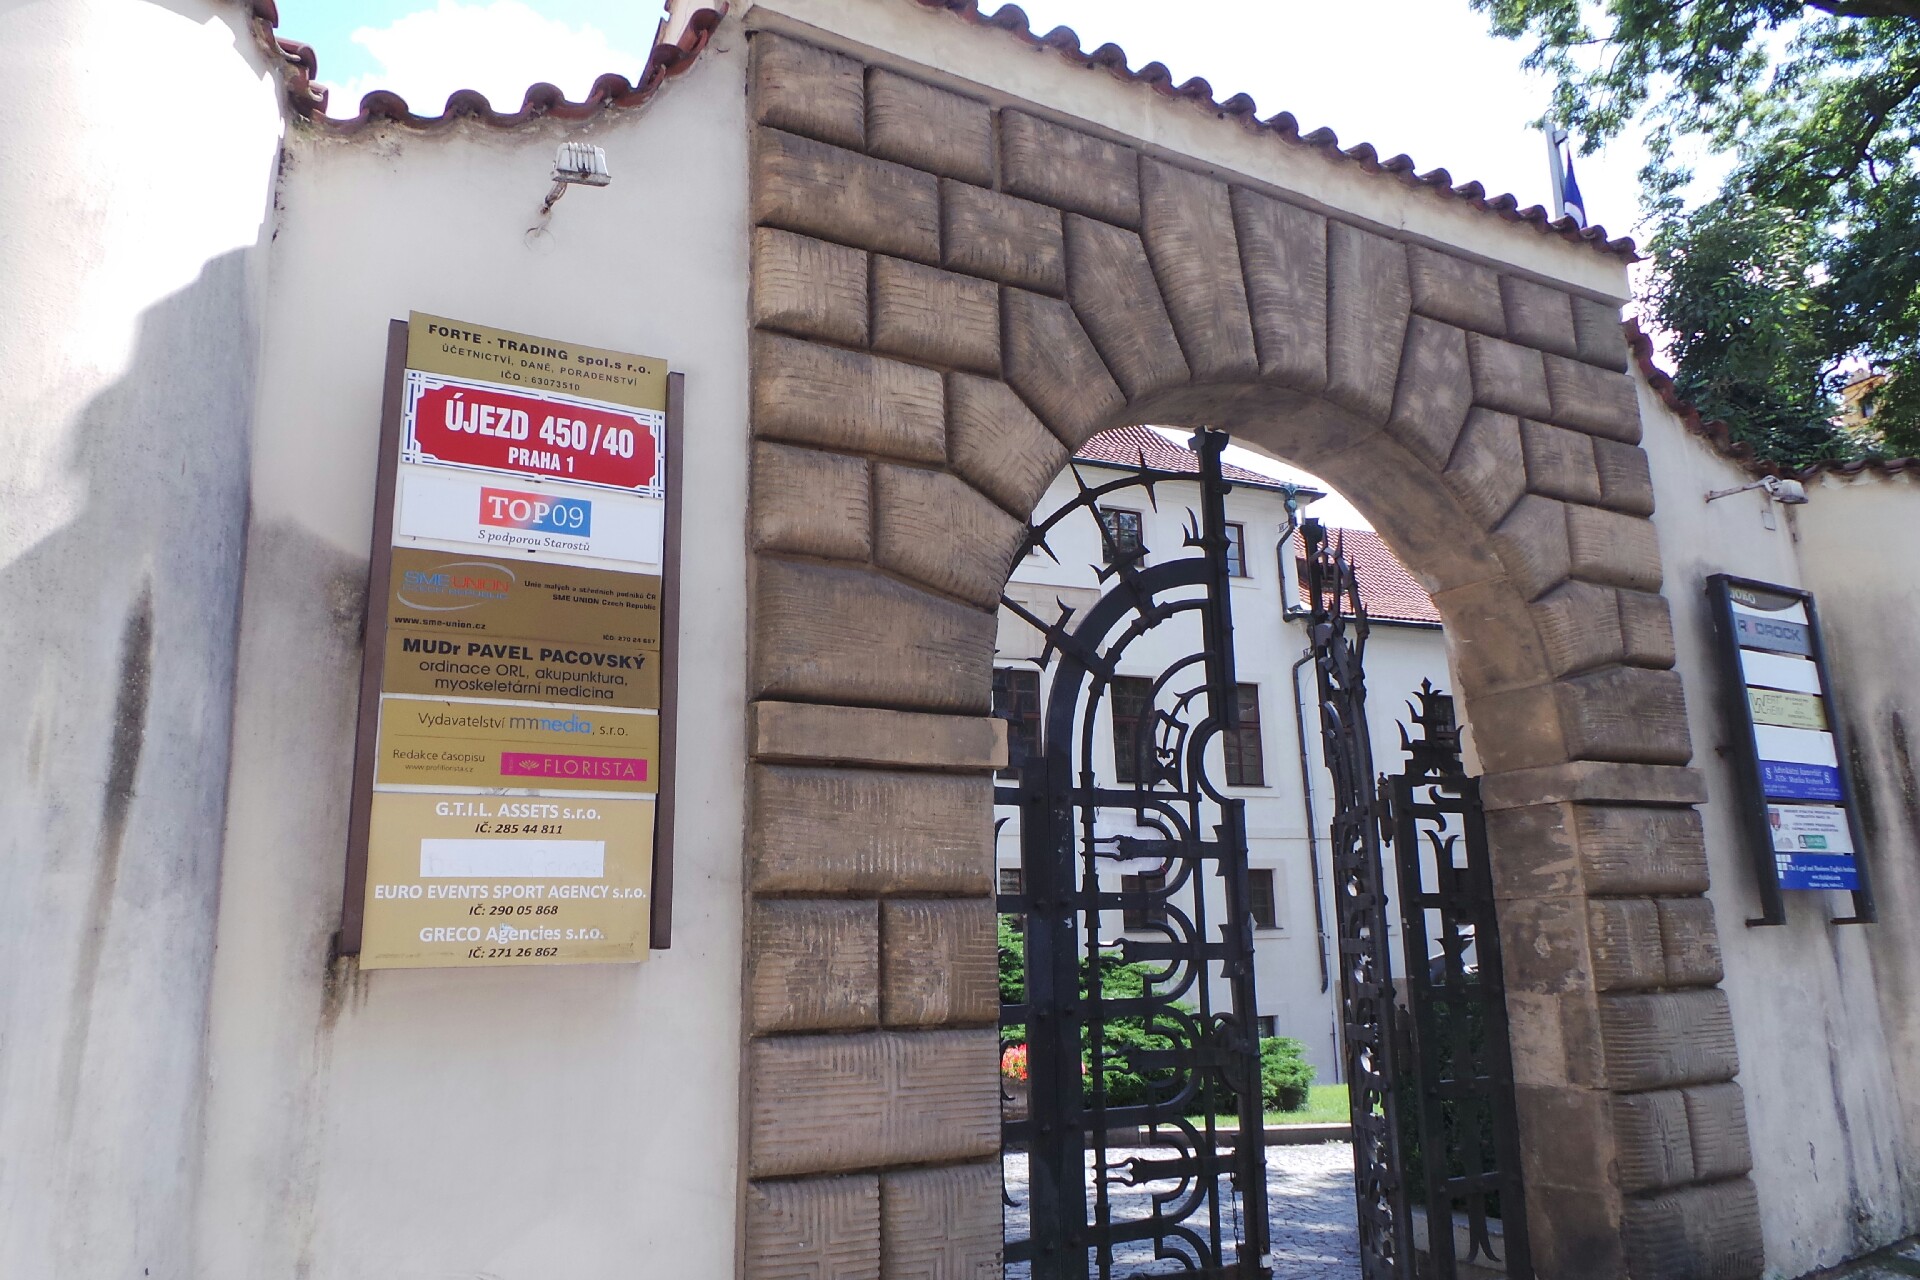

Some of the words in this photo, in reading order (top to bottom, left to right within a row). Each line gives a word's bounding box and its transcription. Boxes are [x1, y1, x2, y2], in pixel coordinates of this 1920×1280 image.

[428, 324, 482, 344] FORTE
[497, 338, 568, 360] TRADING
[577, 355, 622, 370] spol.s
[627, 363, 651, 375] r.o.
[442, 343, 514, 366] ÚČETNICTVÍ,
[560, 366, 637, 386] PORADENSTVÍ
[531, 376, 580, 391] 63073510
[445, 392, 529, 441] ÚJEZD
[539, 415, 634, 459] 450/40
[508, 446, 561, 471] PRAHA
[566, 455, 574, 473] 1
[478, 529, 486, 539] S
[487, 532, 541, 546] podporou
[544, 537, 590, 552] Starostů
[404, 570, 449, 587] SME
[451, 575, 510, 593] UNION
[524, 580, 541, 588] Unie
[544, 583, 570, 592] malých
[579, 587, 614, 596] středních
[616, 591, 644, 600] podniků
[552, 594, 570, 602] SME
[573, 596, 599, 605] UNION
[601, 599, 623, 607] Czech
[626, 601, 656, 610] Republic
[395, 616, 486, 630] www.sme-union.cz
[403, 638, 461, 655] MUDr
[467, 642, 534, 661] PAVEL
[540, 648, 646, 670] PACOVSKÝ
[419, 660, 490, 675] ordinace
[496, 663, 530, 679] ORL,
[535, 667, 628, 687] akupunktura,
[435, 678, 541, 694] myoskeletární
[545, 685, 614, 699] medicina
[418, 712, 506, 729] Vydavatelství
[599, 725, 628, 736] s.r.o.
[392, 749, 438, 760] Redakce
[441, 751, 485, 763] časopisu
[544, 759, 635, 777] FLORISTA
[435, 802, 492, 817] G.T.I.L.
[498, 803, 559, 819] ASSETS
[562, 807, 601, 820] s.r.o.
[475, 821, 492, 833] IČ:
[495, 823, 519, 834] 285
[522, 824, 538, 834] 44
[541, 824, 563, 835] 811
[374, 885, 422, 899] EURO
[427, 885, 489, 899] EVENTS
[492, 884, 545, 899] SPORT
[548, 884, 609, 899] AGENCY
[612, 887, 646, 899] s.r.o.
[469, 903, 485, 916] IČ:
[489, 905, 513, 916] 290
[516, 905, 532, 915] 05
[535, 905, 559, 915] 868
[419, 927, 481, 942] GRECO
[485, 925, 561, 944] Agencies
[565, 927, 604, 940] s.r.o.
[468, 946, 485, 959] IČ:
[488, 948, 512, 958] 271
[516, 947, 532, 957] 26
[535, 947, 558, 957] 862
